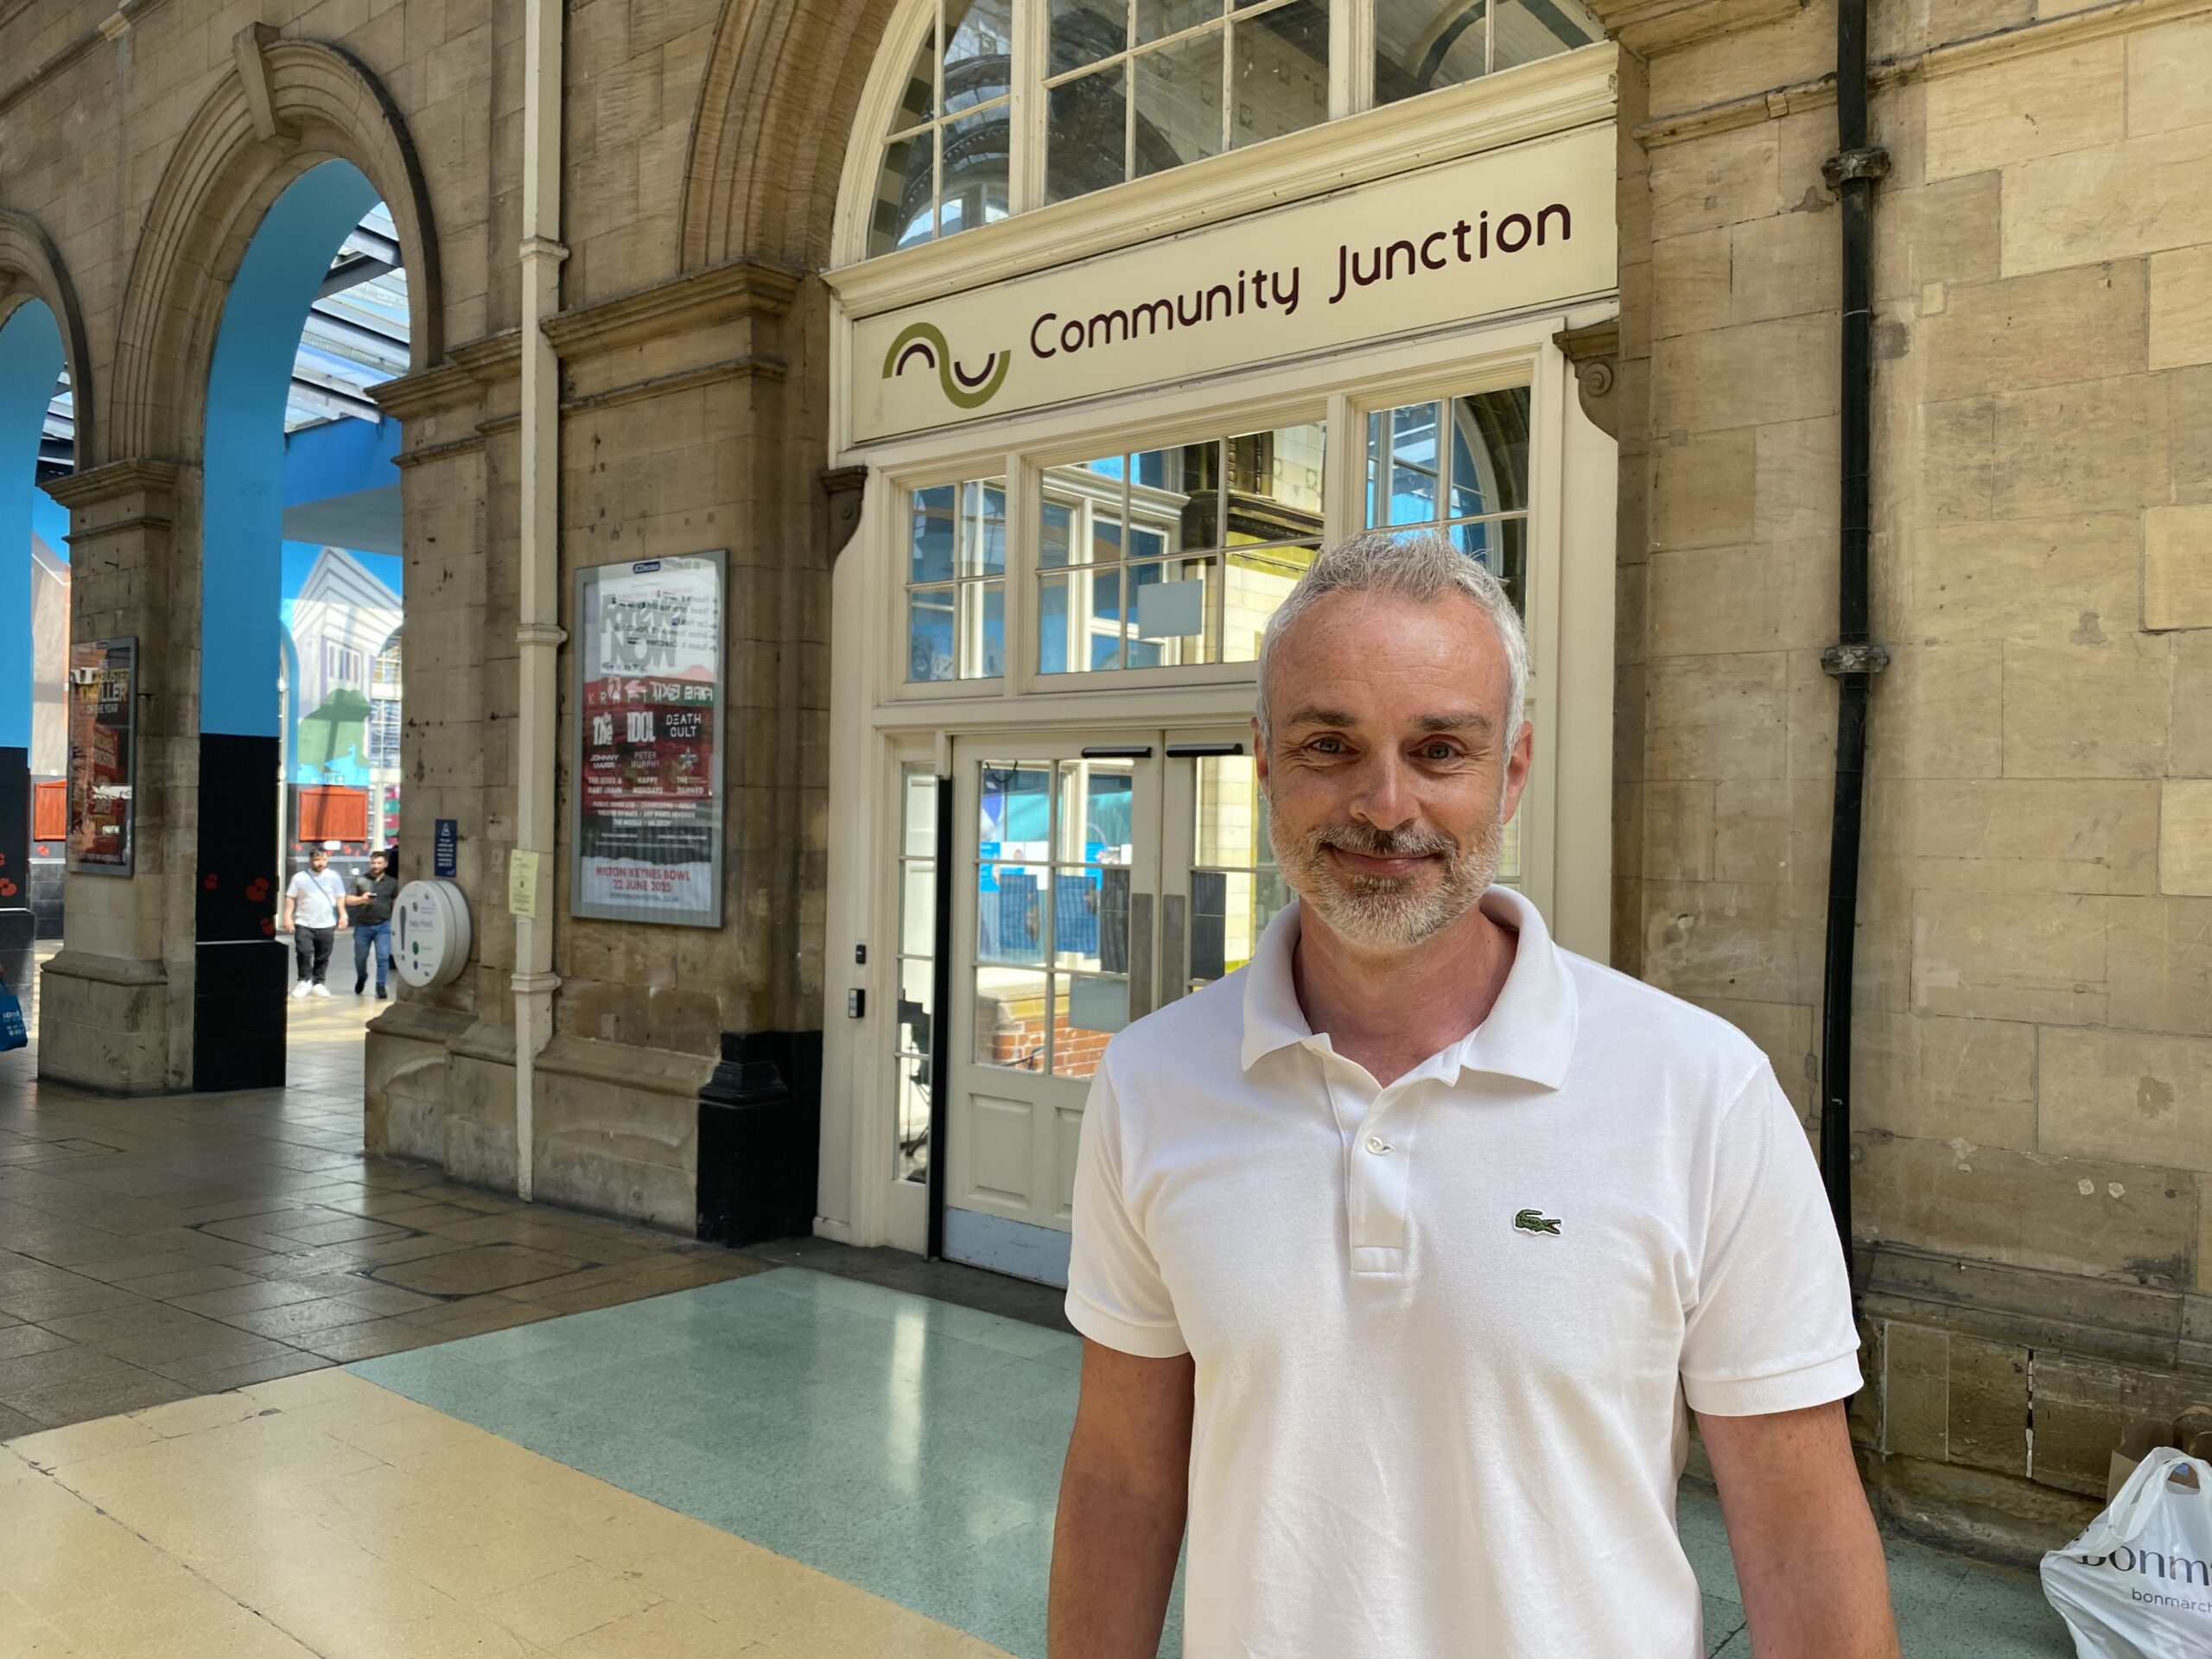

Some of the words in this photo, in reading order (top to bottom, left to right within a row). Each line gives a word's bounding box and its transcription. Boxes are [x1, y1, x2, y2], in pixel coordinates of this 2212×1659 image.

[1030, 266, 1300, 359] Community
[1330, 202, 1571, 304] Junction
[666, 714, 701, 725] DEATH
[626, 712, 656, 743] IDOL
[671, 726, 696, 737] CULT
[634, 751, 657, 760] PETER
[631, 760, 660, 768] MURPHY
[596, 867, 626, 877] MILTON
[629, 868, 662, 880] KEYNES
[664, 869, 691, 881] BOWL
[613, 879, 623, 890] 22
[626, 880, 648, 891] JUNE
[650, 881, 671, 893] 2025
[2076, 1545, 2212, 1586] onm
